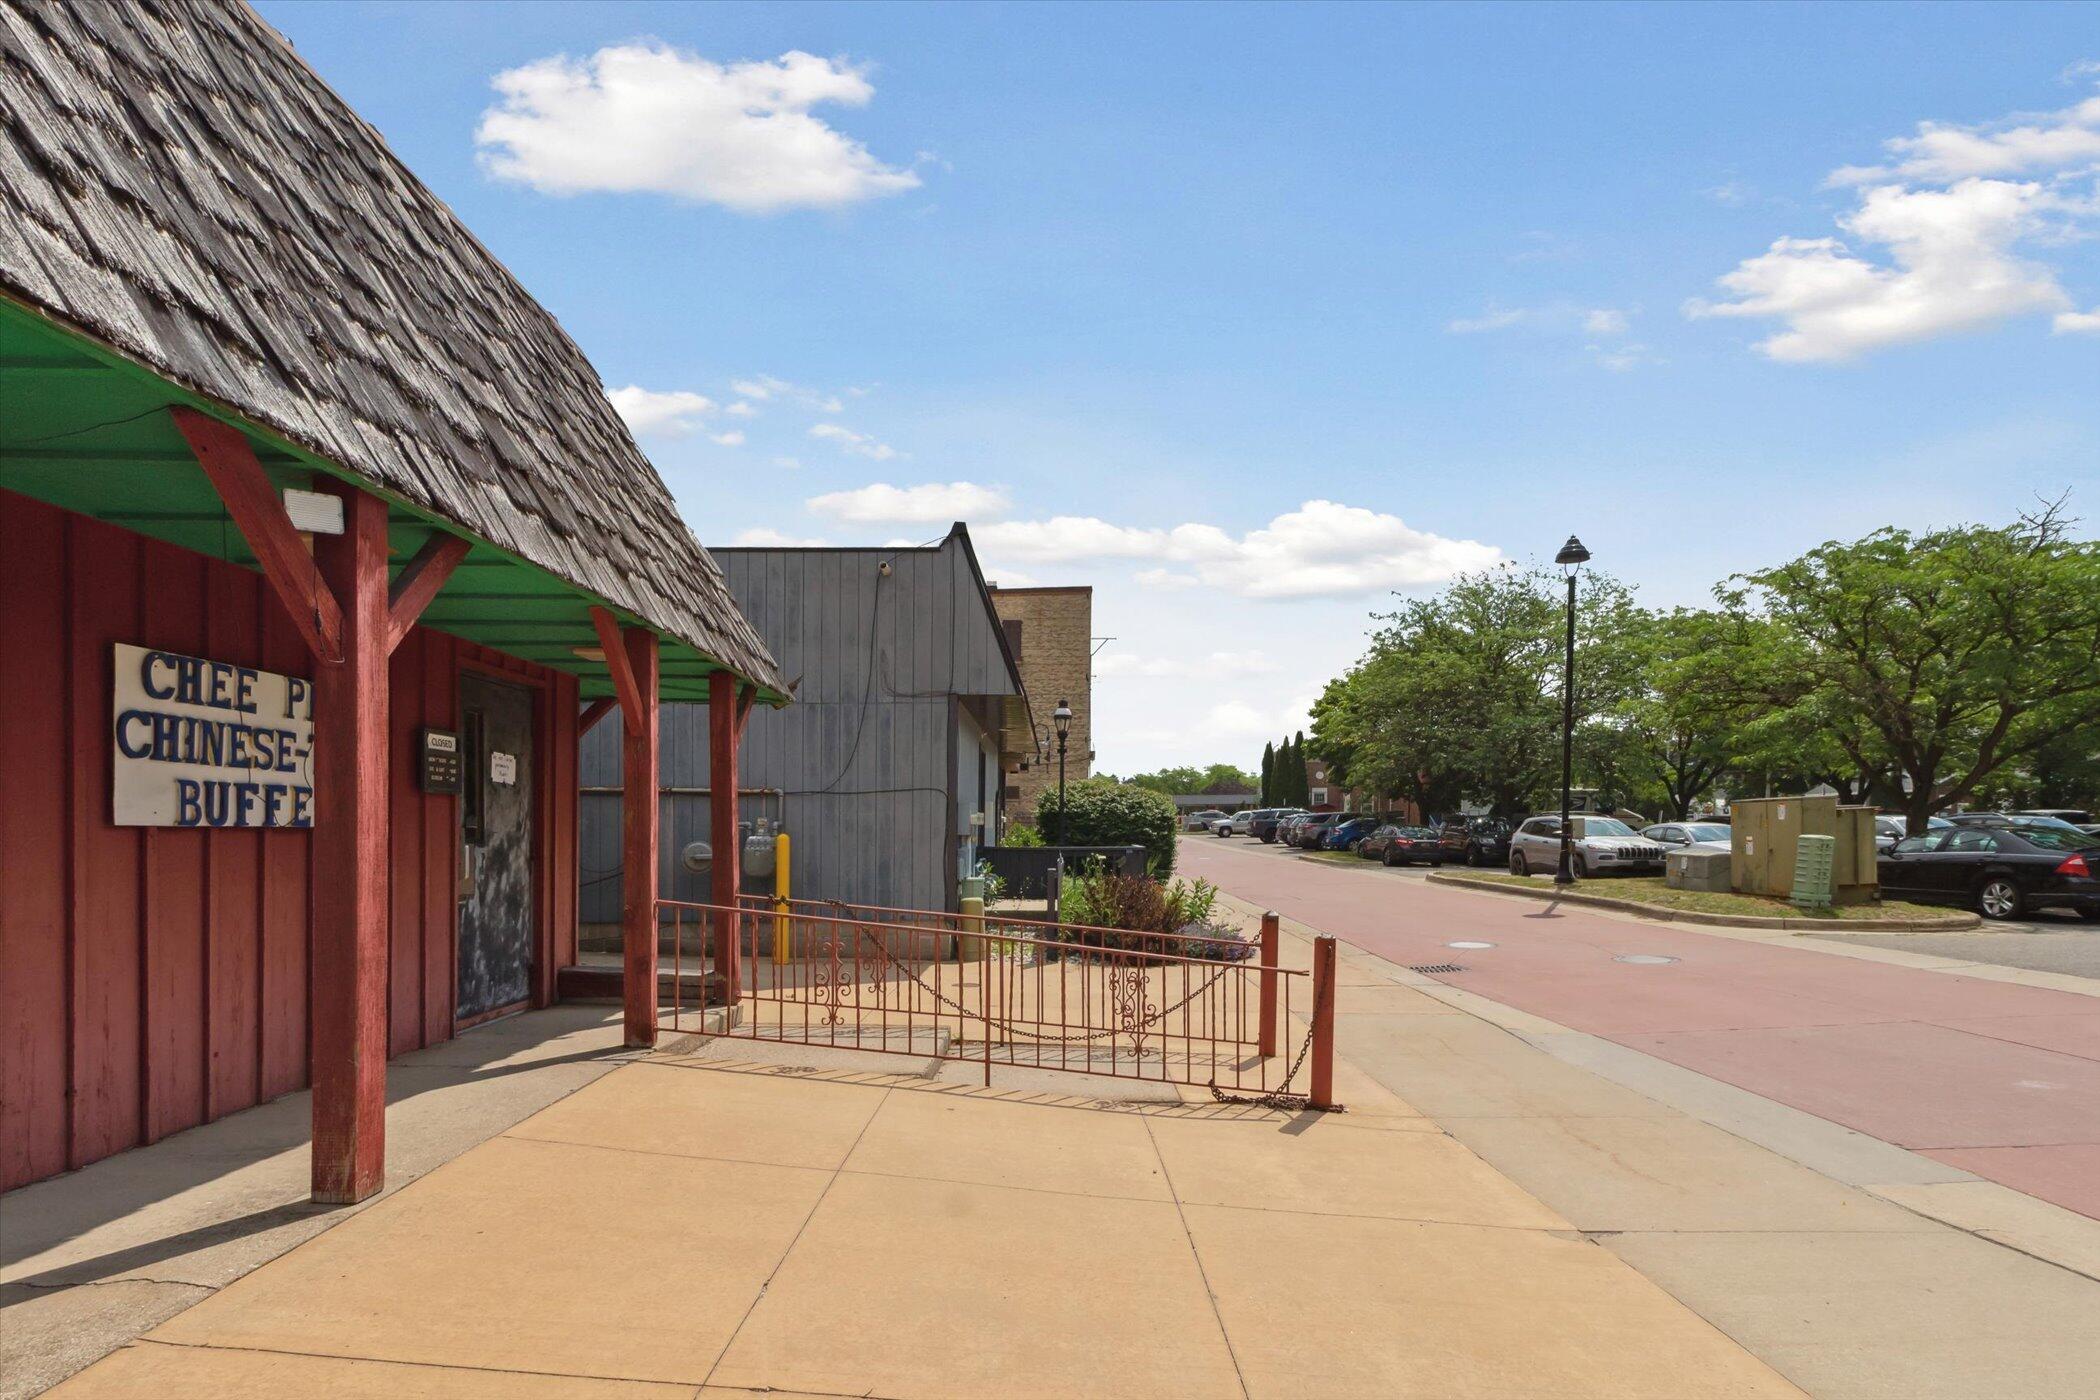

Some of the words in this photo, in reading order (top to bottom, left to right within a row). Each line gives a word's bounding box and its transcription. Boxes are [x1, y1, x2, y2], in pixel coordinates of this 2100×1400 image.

[141, 652, 258, 714] CHEE
[116, 709, 314, 772] CHINESE-
[431, 737, 453, 749] CLOSED
